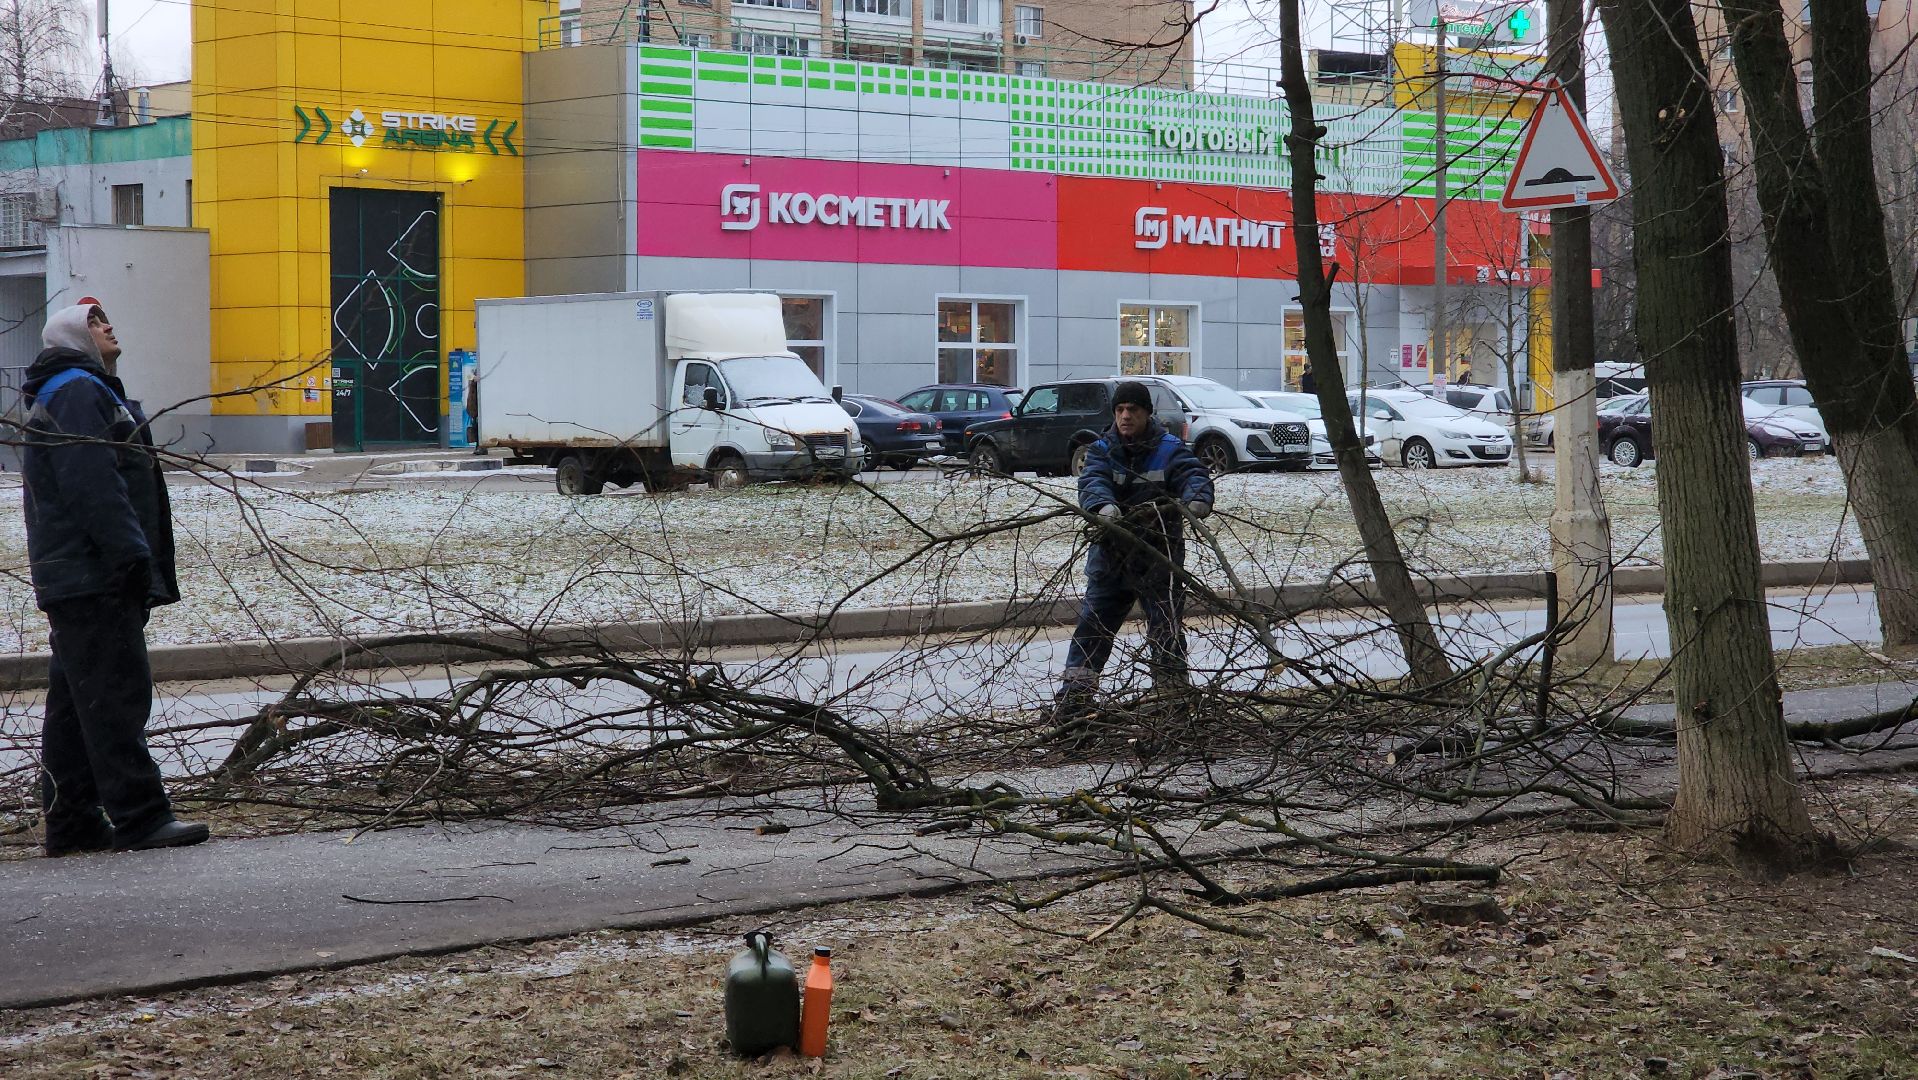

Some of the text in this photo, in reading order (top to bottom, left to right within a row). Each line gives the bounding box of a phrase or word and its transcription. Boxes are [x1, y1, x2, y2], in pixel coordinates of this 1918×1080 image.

[382, 111, 477, 132] STRIKE
[383, 127, 476, 148] ARENA
[768, 191, 952, 230] КОСМЕТИК
[1172, 214, 1287, 249] МАГНИТ
[335, 389, 351, 397] 24/7
